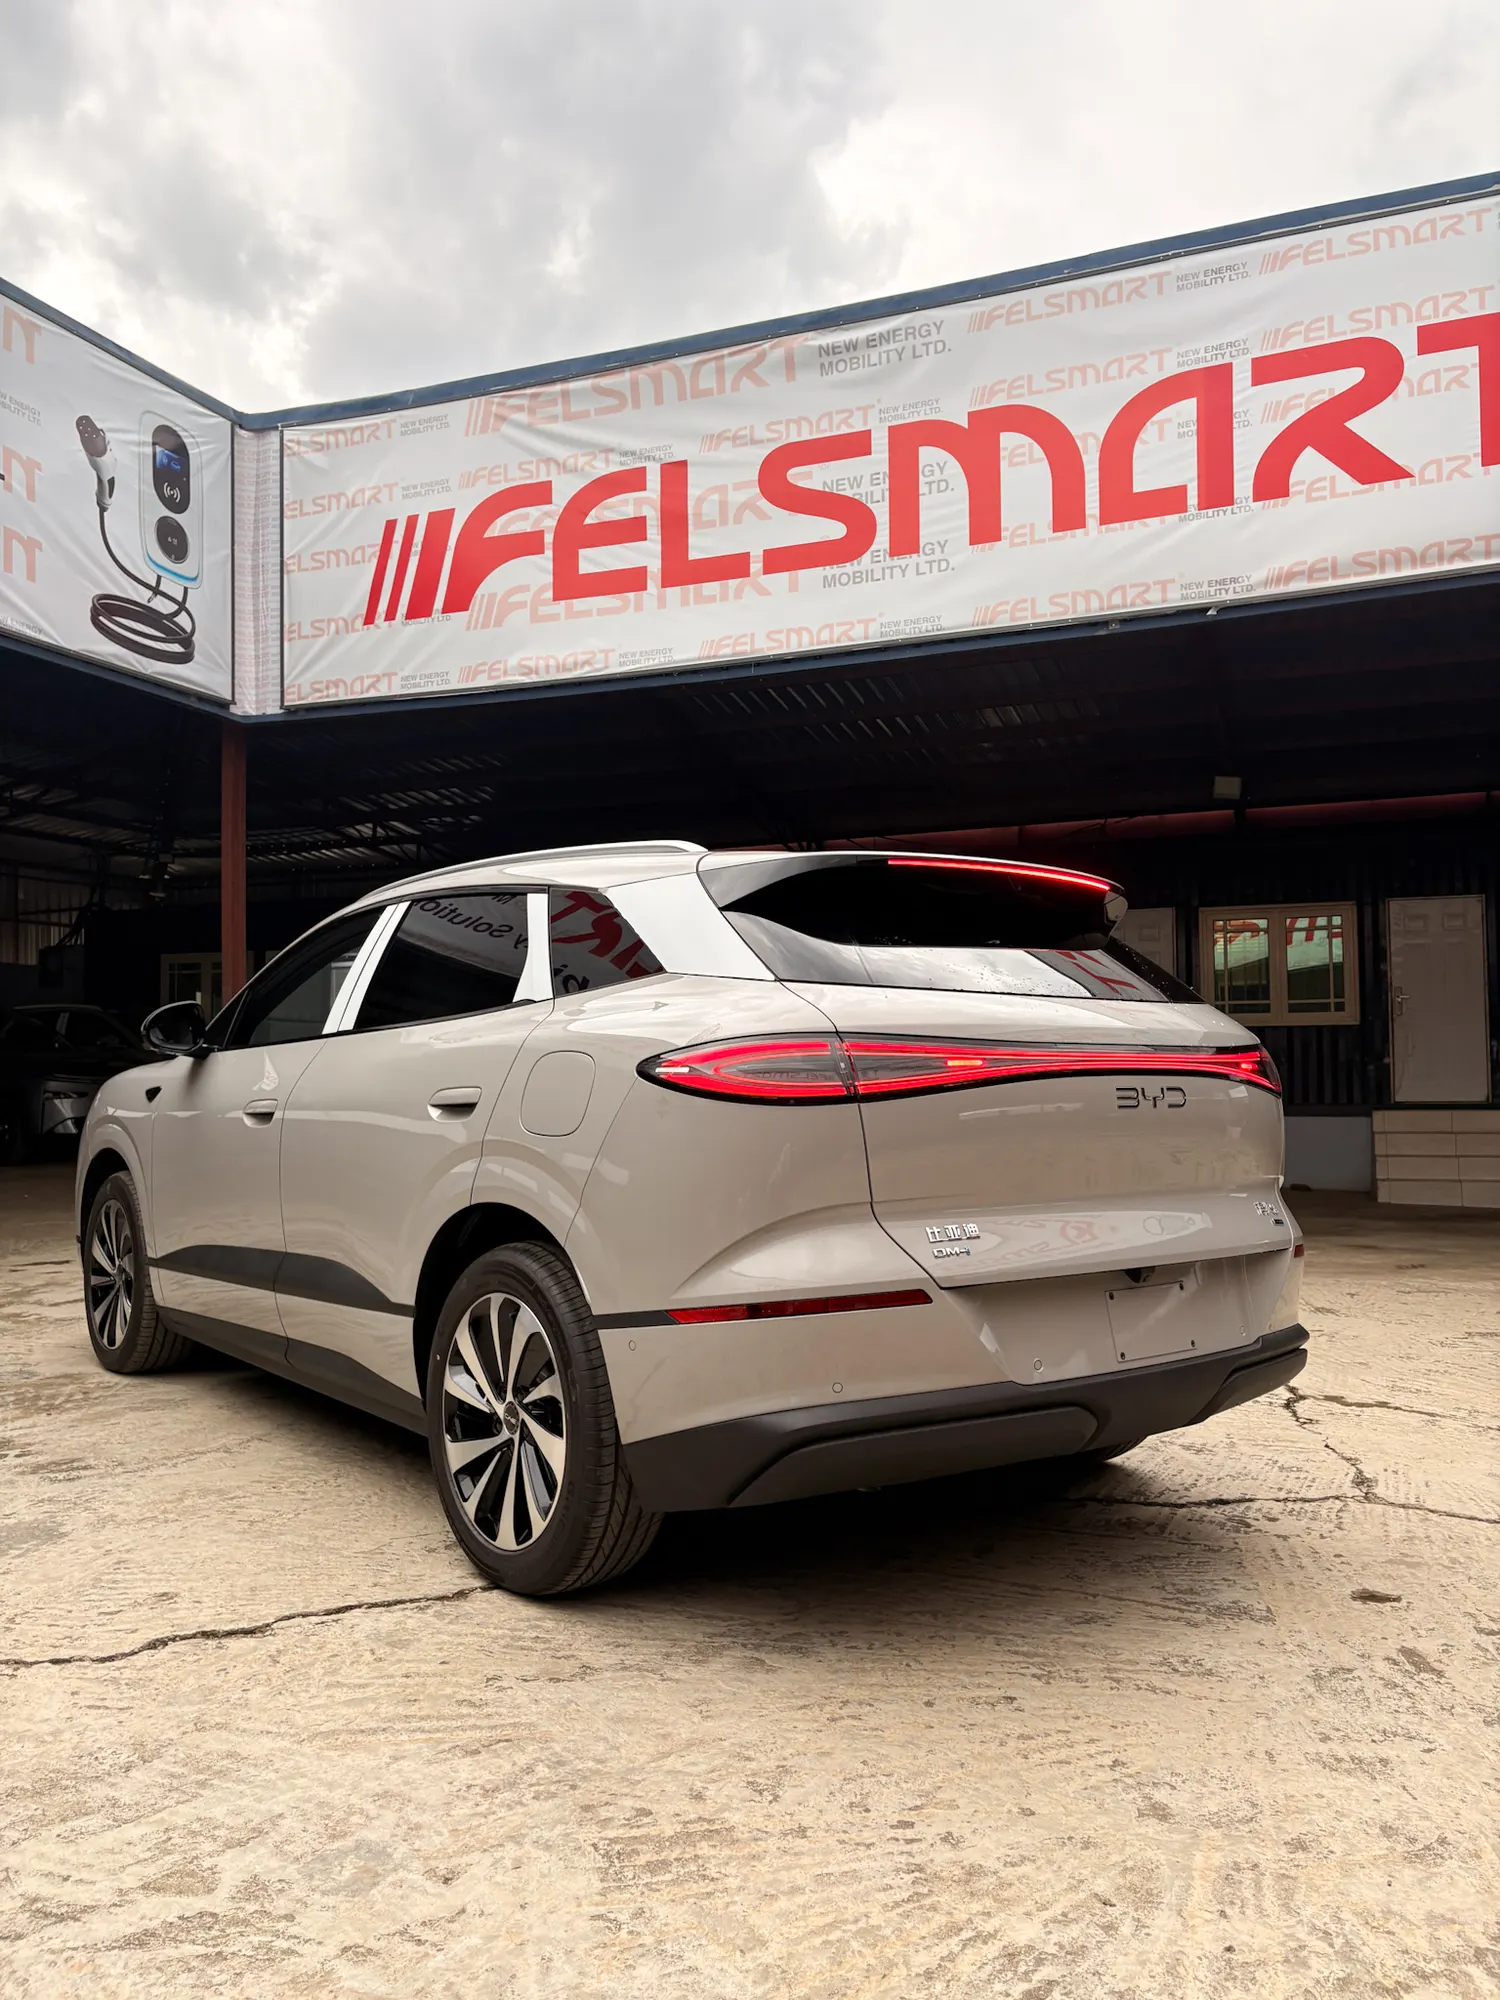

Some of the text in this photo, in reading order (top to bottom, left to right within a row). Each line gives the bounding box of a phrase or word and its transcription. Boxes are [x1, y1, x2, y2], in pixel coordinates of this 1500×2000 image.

[1262, 208, 1492, 274] FELSMART
[1176, 261, 1248, 283] NEW ENERGY
[1176, 275, 1226, 293] MOBILITY
[970, 270, 1172, 333] FELSMART
[1263, 284, 1495, 351] FELSMART
[818, 319, 944, 358] NEW ENERGY
[819, 339, 952, 377] MOBILITY LTD.
[1177, 338, 1249, 360] NEW ENERGY
[1177, 352, 1227, 369] MOBILITY
[971, 347, 1172, 407] FELSMART
[879, 398, 941, 416] NEW ENERGY
[401, 414, 449, 429] NEW ENERGY
[879, 410, 922, 424] MOBILITY
[401, 424, 434, 437] MOBILITY
[702, 404, 875, 453] FELSMART
[619, 444, 674, 459] NEW ENERGY
[619, 454, 657, 467] MOBILITY
[460, 447, 616, 488] FELSMART
[402, 478, 450, 493] NEW ENERGY
[402, 488, 436, 500] MOBILITY
[1178, 507, 1228, 523] MOBILITY
[1266, 533, 1500, 590] FELSMART
[823, 558, 955, 589] MOBILITY LTD.
[1180, 574, 1252, 592] NEW ENERGY
[974, 578, 1175, 626] FELSMART
[1181, 587, 1230, 601] MOBILITY
[880, 615, 942, 630] NEW ENERGY
[700, 617, 877, 660] FELSMART
[880, 626, 923, 639] MOBILITY
[619, 647, 674, 661] NEW ENERGY
[619, 657, 657, 668] MOBILITY
[459, 648, 616, 683] FELSMART
[401, 671, 450, 683] NEW ENERGY
[401, 680, 434, 690] MOBILITY
[1115, 1086, 1187, 1109] BYD
[926, 1223, 980, 1243] 比亚迪
